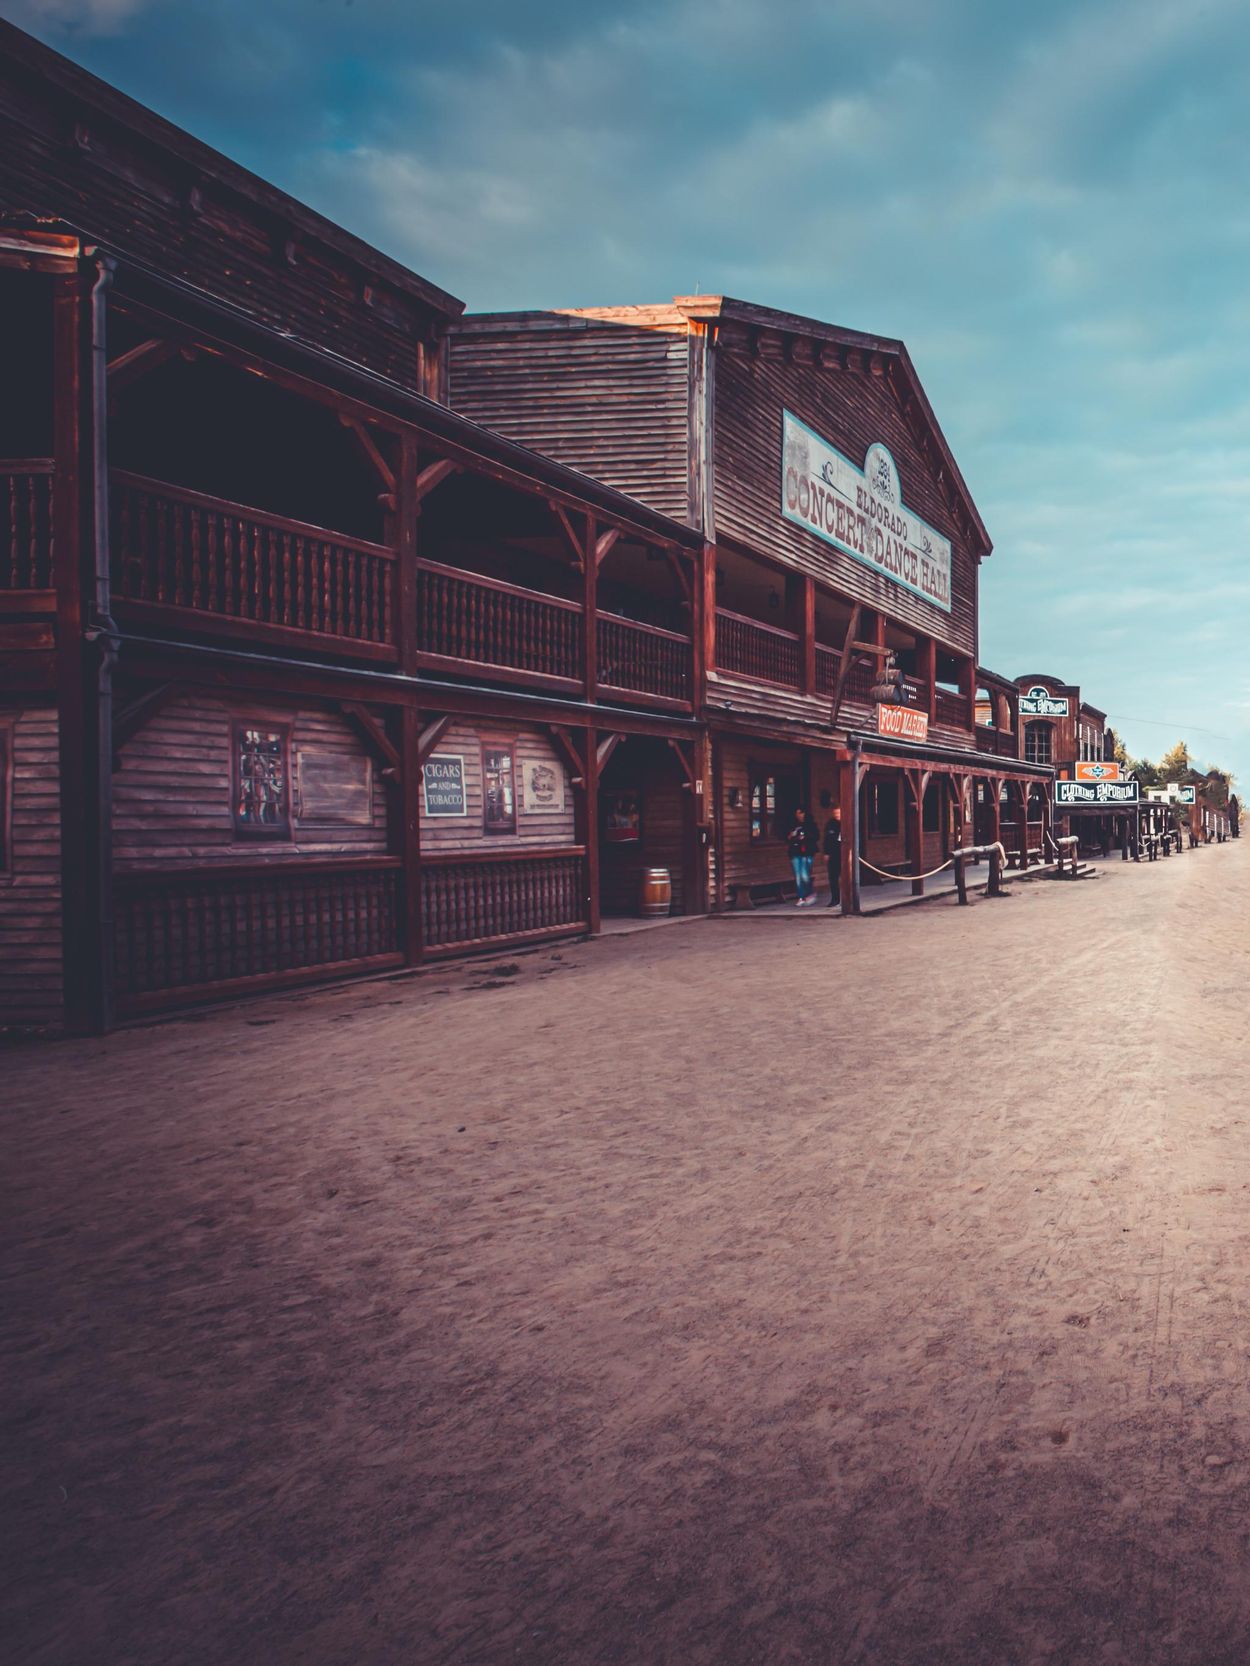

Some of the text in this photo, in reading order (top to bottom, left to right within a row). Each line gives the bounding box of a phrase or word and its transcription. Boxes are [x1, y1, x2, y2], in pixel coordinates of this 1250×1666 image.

[856, 485, 908, 542] ELDORADO
[786, 465, 866, 554] CONCERT
[874, 526, 918, 586] DANCE
[921, 559, 949, 604] HALL
[881, 706, 902, 733] FOOD
[425, 763, 461, 778] CIGARS
[437, 782, 451, 791] AND
[1061, 784, 1134, 800] CLOTHING EMPORIUM
[428, 794, 462, 806] TOBACCO
